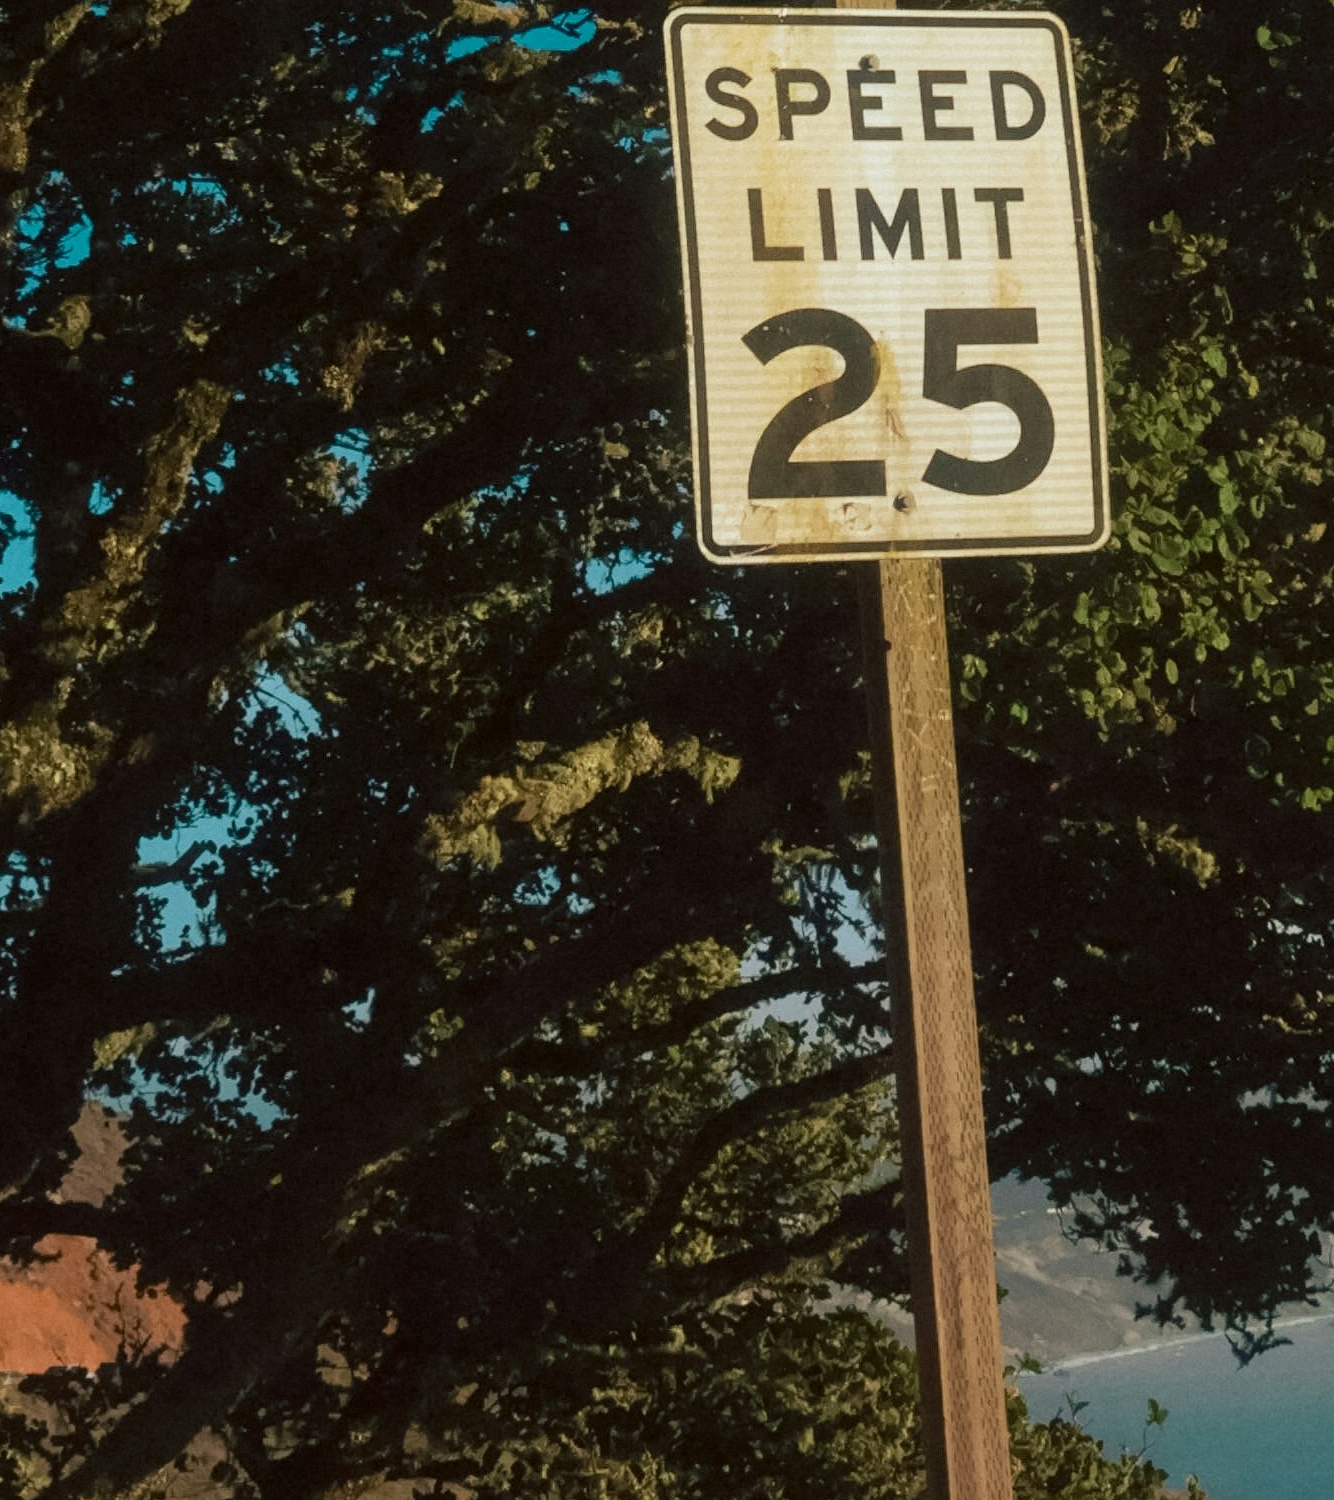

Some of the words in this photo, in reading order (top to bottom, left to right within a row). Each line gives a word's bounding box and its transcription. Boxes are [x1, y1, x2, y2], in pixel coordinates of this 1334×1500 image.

[704, 67, 1046, 141] SPEED
[747, 188, 1024, 261] LIMIT
[741, 307, 1055, 499] 25
